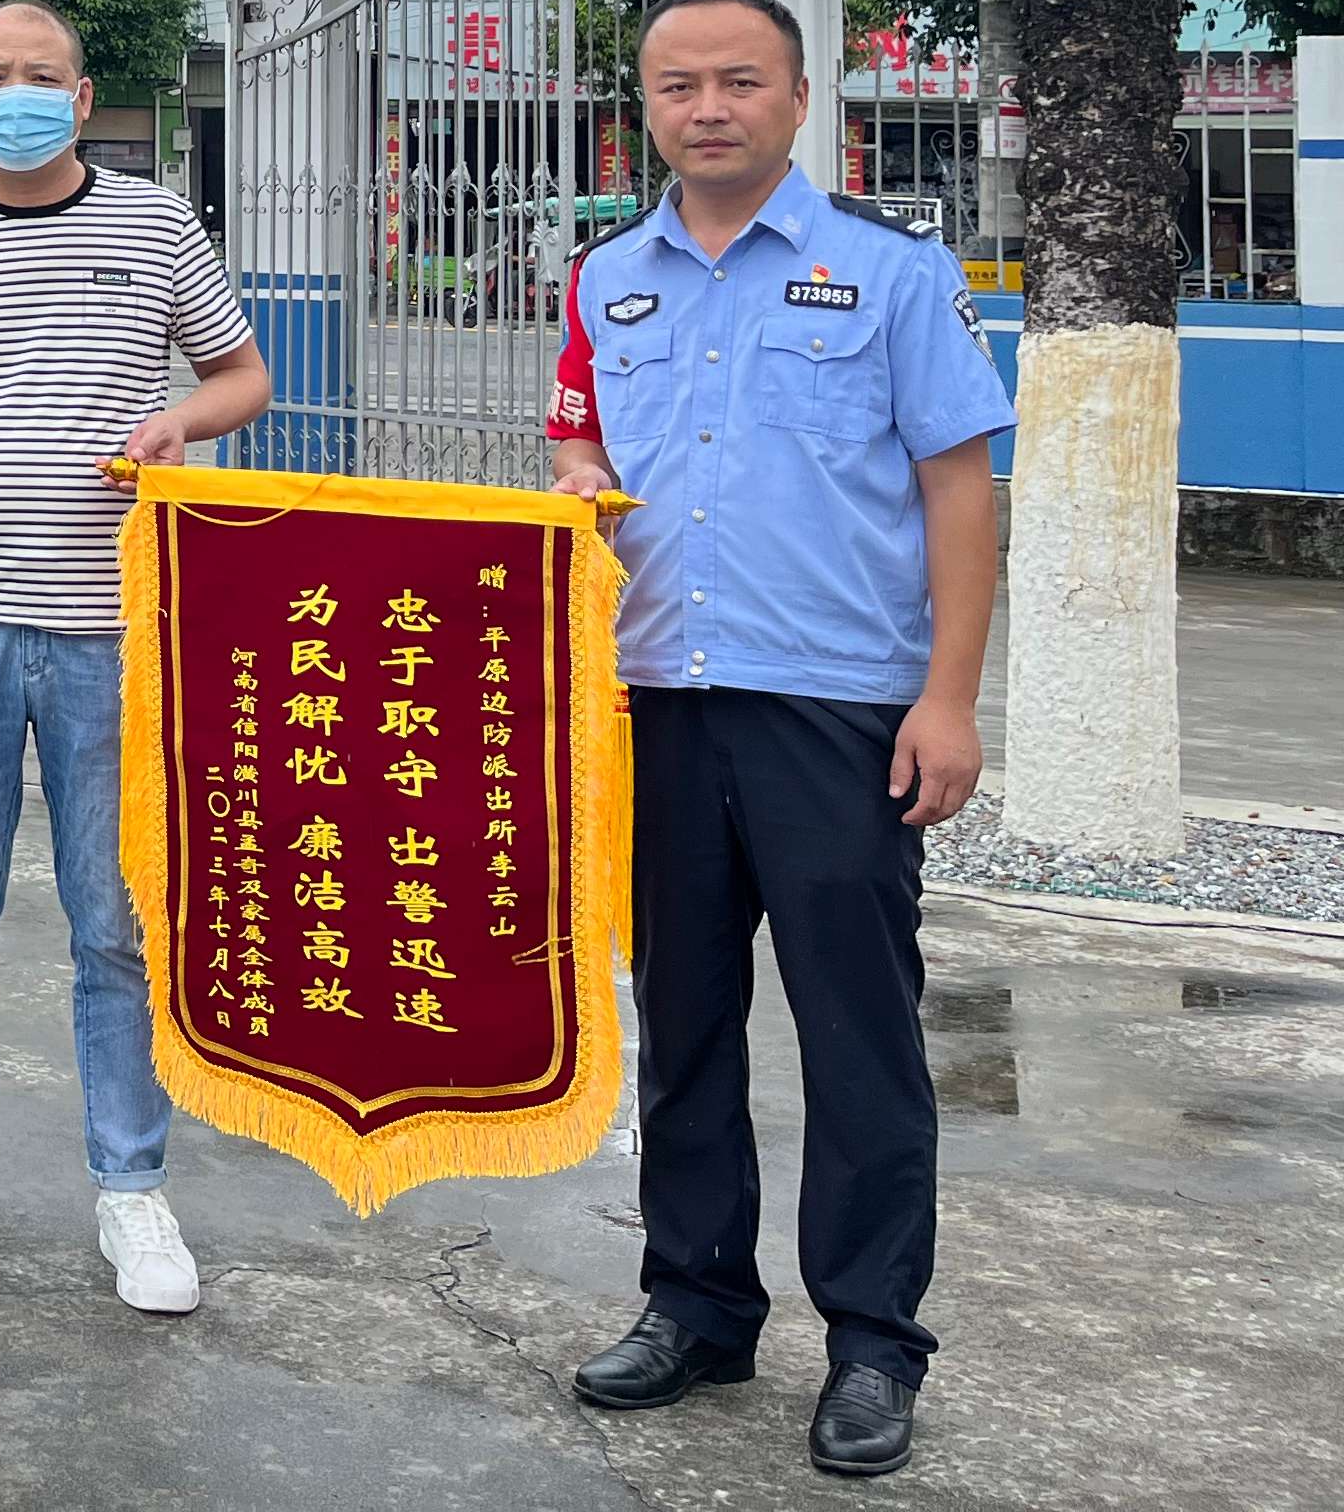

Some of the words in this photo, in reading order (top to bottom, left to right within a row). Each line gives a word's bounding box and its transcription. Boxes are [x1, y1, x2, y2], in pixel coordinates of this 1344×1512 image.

[789, 285, 853, 305] 373955
[281, 583, 364, 1020] 为民解忧廉洁高效
[376, 588, 459, 1033] 忠于职守出警迅速
